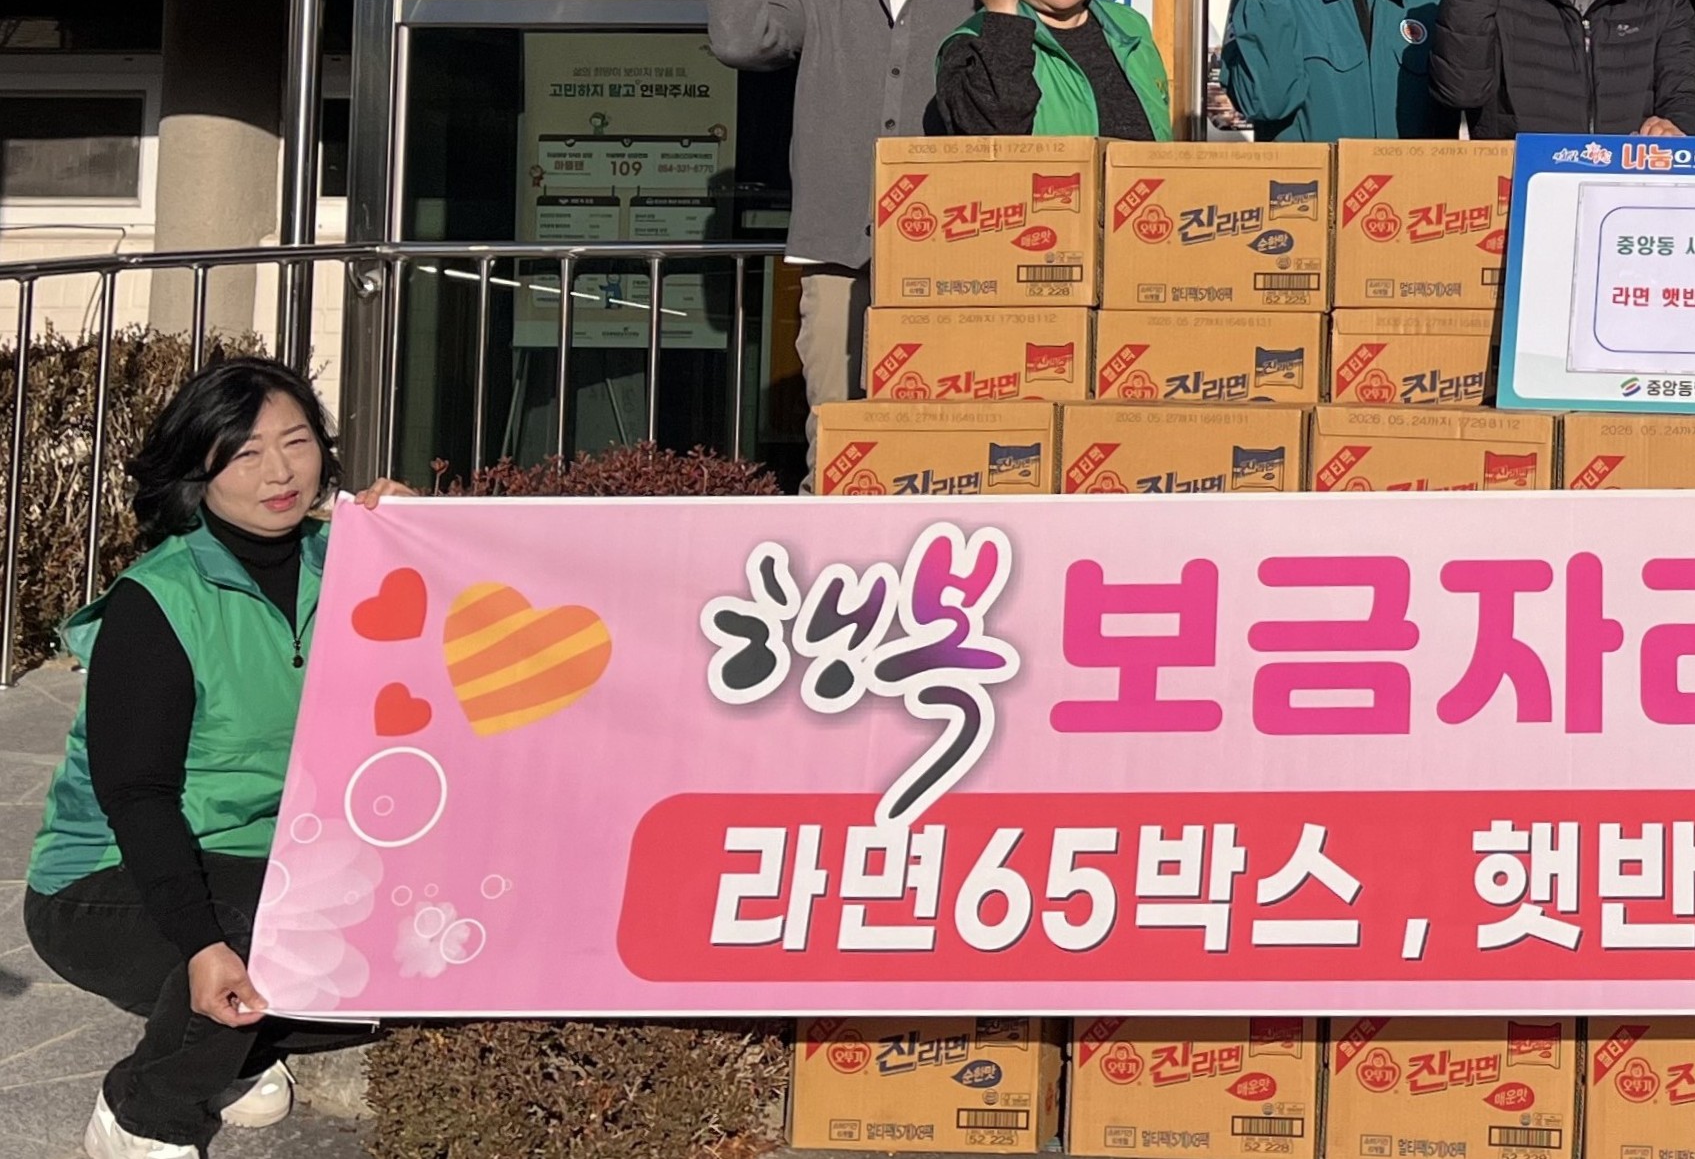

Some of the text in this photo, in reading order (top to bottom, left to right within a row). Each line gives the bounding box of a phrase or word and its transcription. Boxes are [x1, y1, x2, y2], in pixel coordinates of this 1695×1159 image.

[549, 83, 710, 99] 고민하지 말고 연락주세요
[610, 161, 642, 176] 109
[881, 176, 914, 212] 멀티팩
[1116, 182, 1150, 217] 멀티팩
[1345, 177, 1378, 213] 멀티팩
[905, 220, 930, 232] 오뚜기
[942, 201, 1027, 242] 진라면
[1140, 223, 1166, 234] 오뚜기
[1177, 204, 1263, 245] 진라면
[1368, 222, 1394, 232] 오뚜기
[1406, 202, 1492, 244] 진라면
[1257, 234, 1288, 251] 순한맛
[1617, 235, 1675, 256] 중앙동
[1612, 287, 1649, 307] 라면
[875, 345, 909, 381] 멀티팩
[1102, 347, 1135, 381] 멀티팩
[1339, 346, 1372, 381] 멀티팩
[935, 370, 1020, 400] 진라면
[1164, 371, 1249, 400] 진라면
[1363, 389, 1388, 400] 오뚜기
[1400, 369, 1486, 404] 진라면
[826, 446, 863, 483] 멀티팩
[1320, 448, 1357, 486] 멀티팩
[701, 522, 1020, 824] 행복
[709, 822, 1362, 953] 라면65박스
[834, 1053, 864, 1064] 오뚜기
[876, 1031, 969, 1076] 진라면
[1107, 1061, 1137, 1074] 오뚜기
[1150, 1041, 1243, 1088] 진라면
[962, 1065, 995, 1084] 순한맛
[1237, 1077, 1270, 1096] 매운맛
[1364, 1068, 1393, 1081] 오뚜기
[1406, 1050, 1501, 1095] 진라면
[1623, 1079, 1650, 1092] 오뚜기
[1494, 1089, 1528, 1106] 매운맛
[969, 1135, 1014, 1145] 52 225
[1245, 1142, 1289, 1152] 52 228
